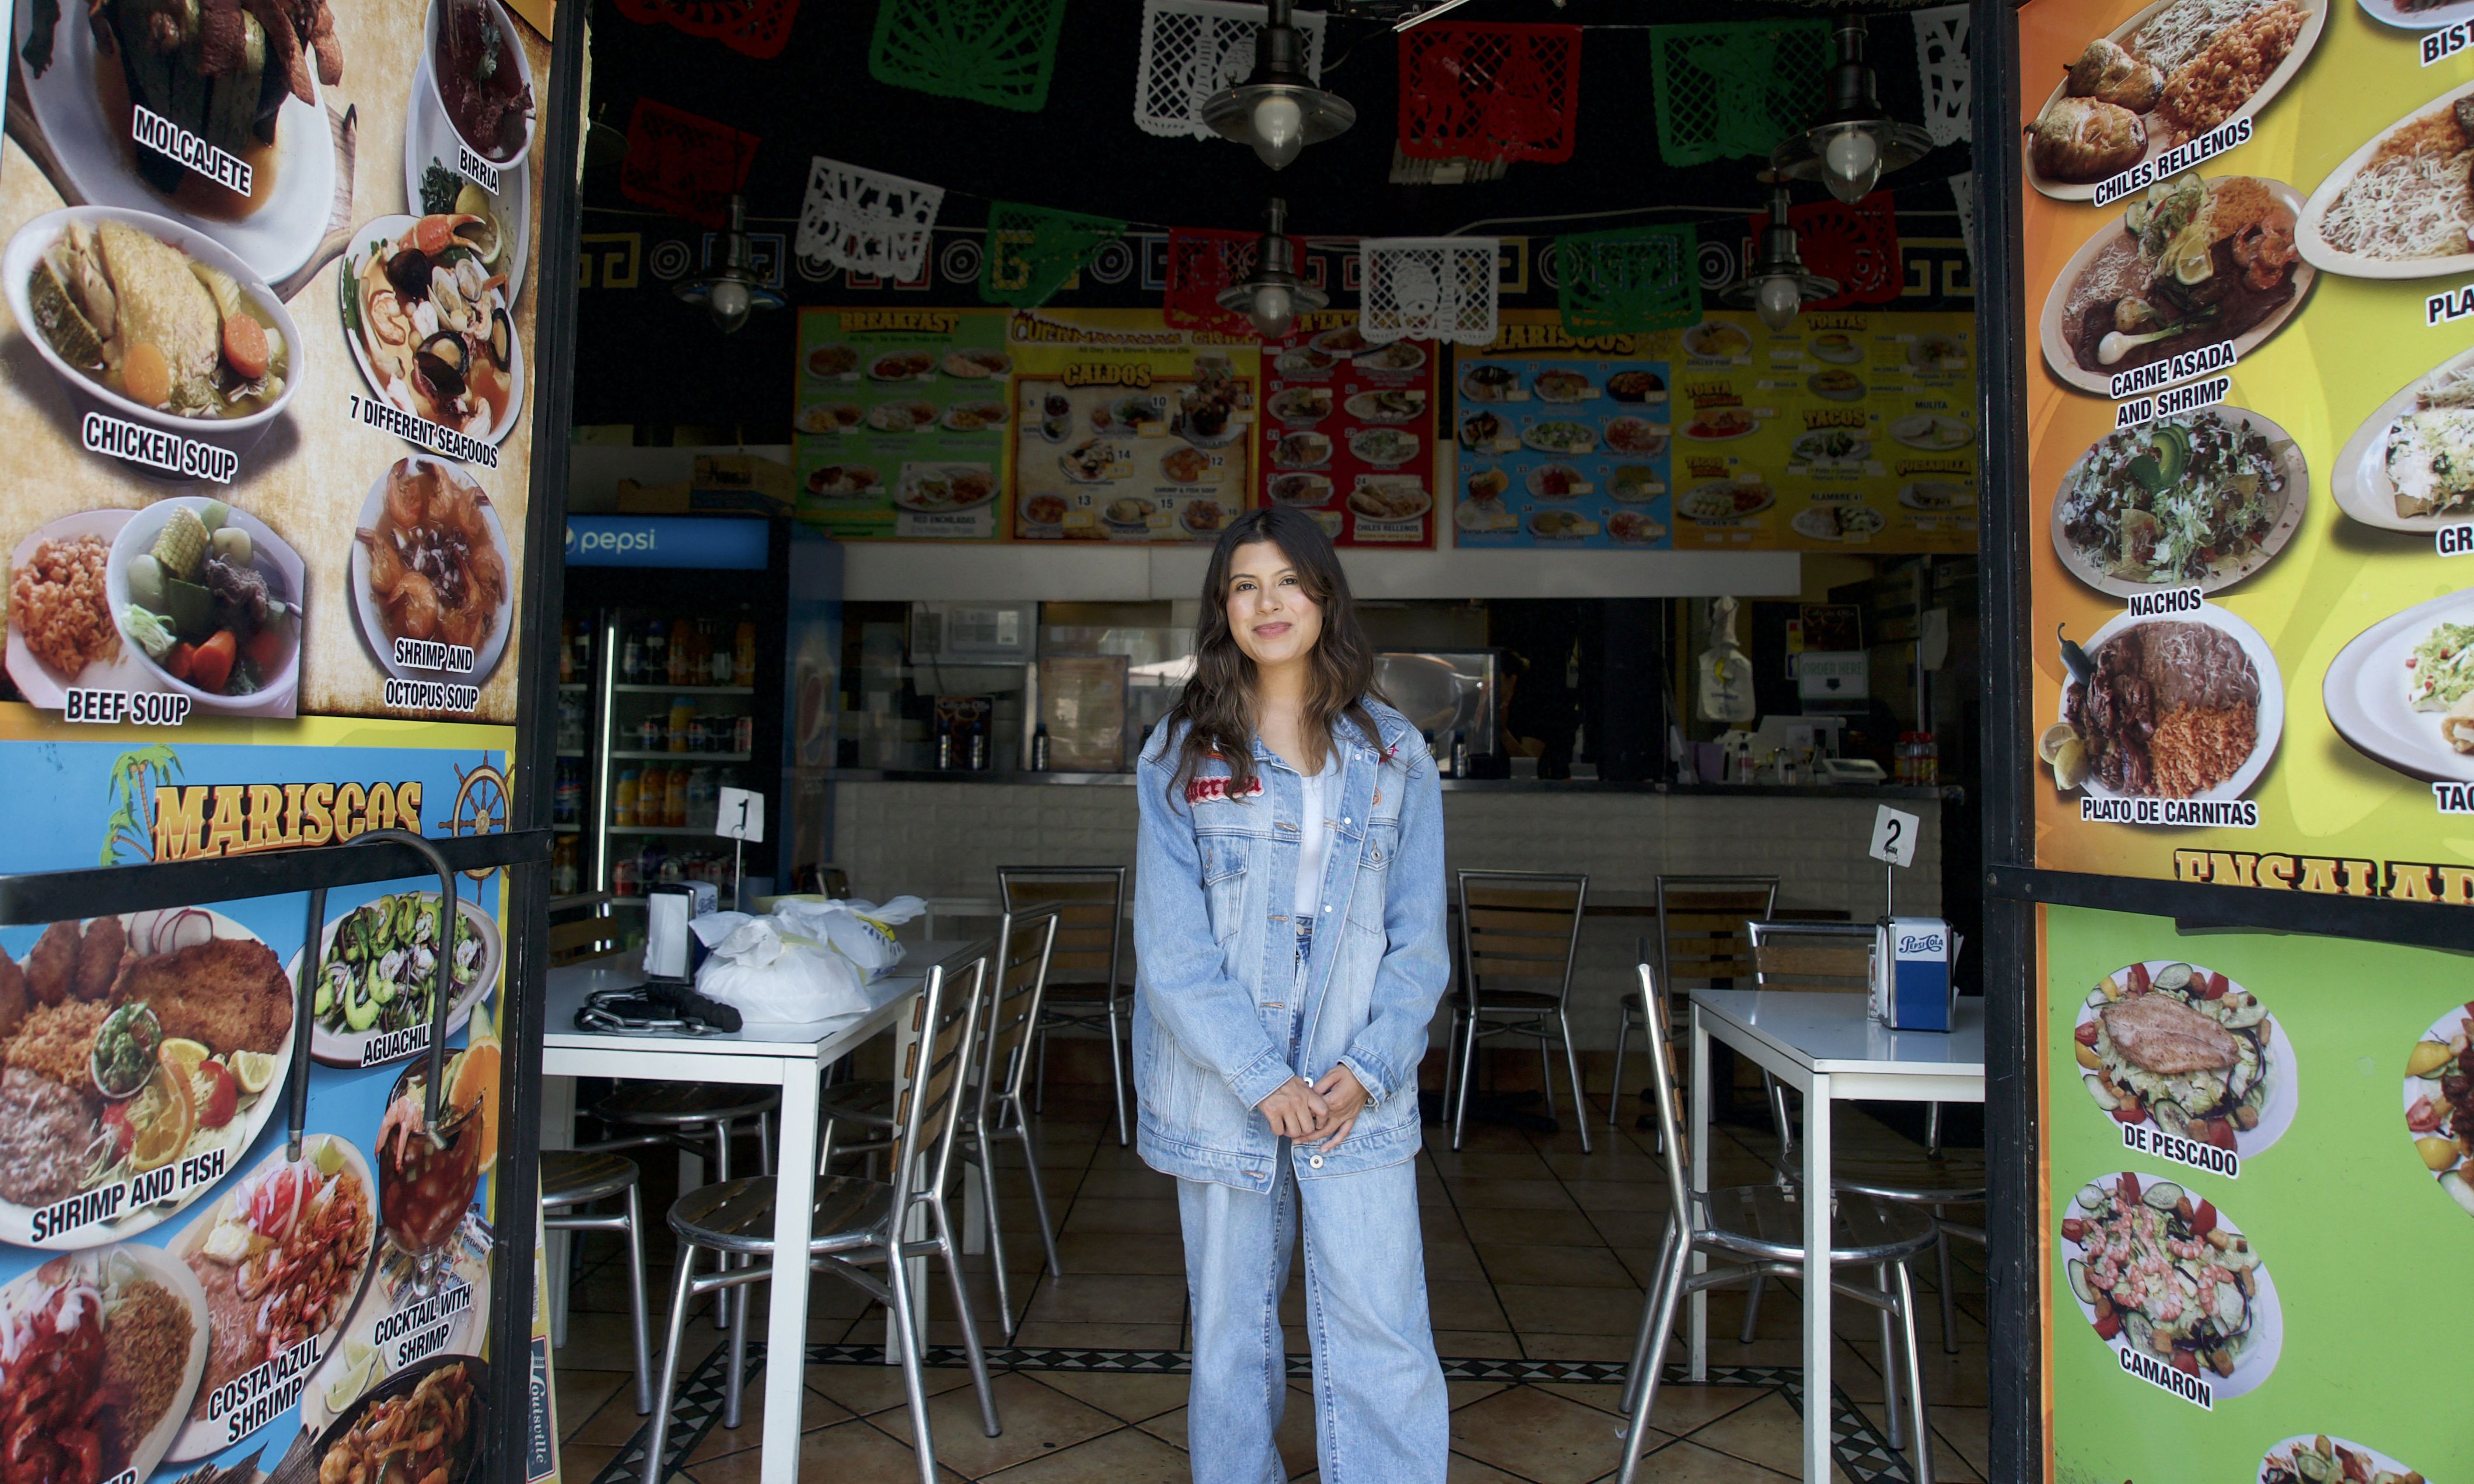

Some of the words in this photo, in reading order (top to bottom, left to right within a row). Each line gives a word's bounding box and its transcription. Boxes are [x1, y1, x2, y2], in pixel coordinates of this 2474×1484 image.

[134, 106, 253, 196] MOLCAJETE
[2095, 161, 2152, 206] CHILES
[2158, 118, 2252, 176] RELLENOS
[460, 147, 499, 194] BIRRIA
[839, 312, 960, 333] BREAKFAST
[1808, 313, 1867, 330] TORTAS
[1064, 363, 1152, 388] CALDOS
[2111, 358, 2168, 398] CARNE
[2171, 342, 2235, 380] ASADA
[1152, 396, 1166, 407] 10
[1914, 401, 1948, 410] MULITA
[2117, 397, 2155, 427] AND
[2157, 377, 2230, 415] SHRIMP
[351, 395, 359, 416] 7
[364, 401, 435, 445] DIFFERENT
[436, 425, 498, 467] SEAFOODS
[1803, 410, 1865, 428] TACOS
[85, 415, 180, 467] CHICKEN
[185, 442, 237, 483] SOUP
[1118, 450, 1131, 459] 14
[1212, 457, 1223, 466] 12
[1686, 456, 1723, 468] TACOS
[1356, 477, 1367, 485] 24
[1078, 496, 1091, 506] 13
[1161, 499, 1173, 509] 15
[580, 528, 656, 555] pepsi
[2130, 588, 2202, 617] NACHOS
[396, 642, 447, 670] SHRIMP
[446, 646, 474, 671] AND
[1804, 662, 1836, 676] ORDER
[1837, 662, 1862, 675] HERE
[67, 691, 126, 721] BEEF
[131, 692, 190, 724] SOUP
[386, 682, 444, 708] OCTOPUS
[446, 685, 478, 710] SOUP
[154, 782, 422, 862] MARISCOS
[739, 799, 749, 828] 1
[2081, 798, 2133, 822] PLATO
[2136, 800, 2160, 823] DE
[2164, 802, 2258, 826] CARNITAS
[1885, 818, 1902, 851] 2
[363, 1023, 433, 1066] AGUACHIL
[2123, 1124, 2147, 1152] DE
[2152, 1135, 2238, 1178] PESCADO
[32, 1182, 126, 1244] SHRIMP
[131, 1164, 176, 1211] AND
[181, 1147, 226, 1191] FISH
[463, 1233, 486, 1256] PREMIUM
[375, 1298, 437, 1346] COCKTAIL
[439, 1284, 471, 1318] WITH
[398, 1324, 450, 1367] SHRIMP
[209, 1364, 271, 1422] COSTA
[274, 1335, 322, 1380] AZUL
[2119, 1347, 2213, 1409] CAMARON
[228, 1378, 304, 1444] SHRIMP
